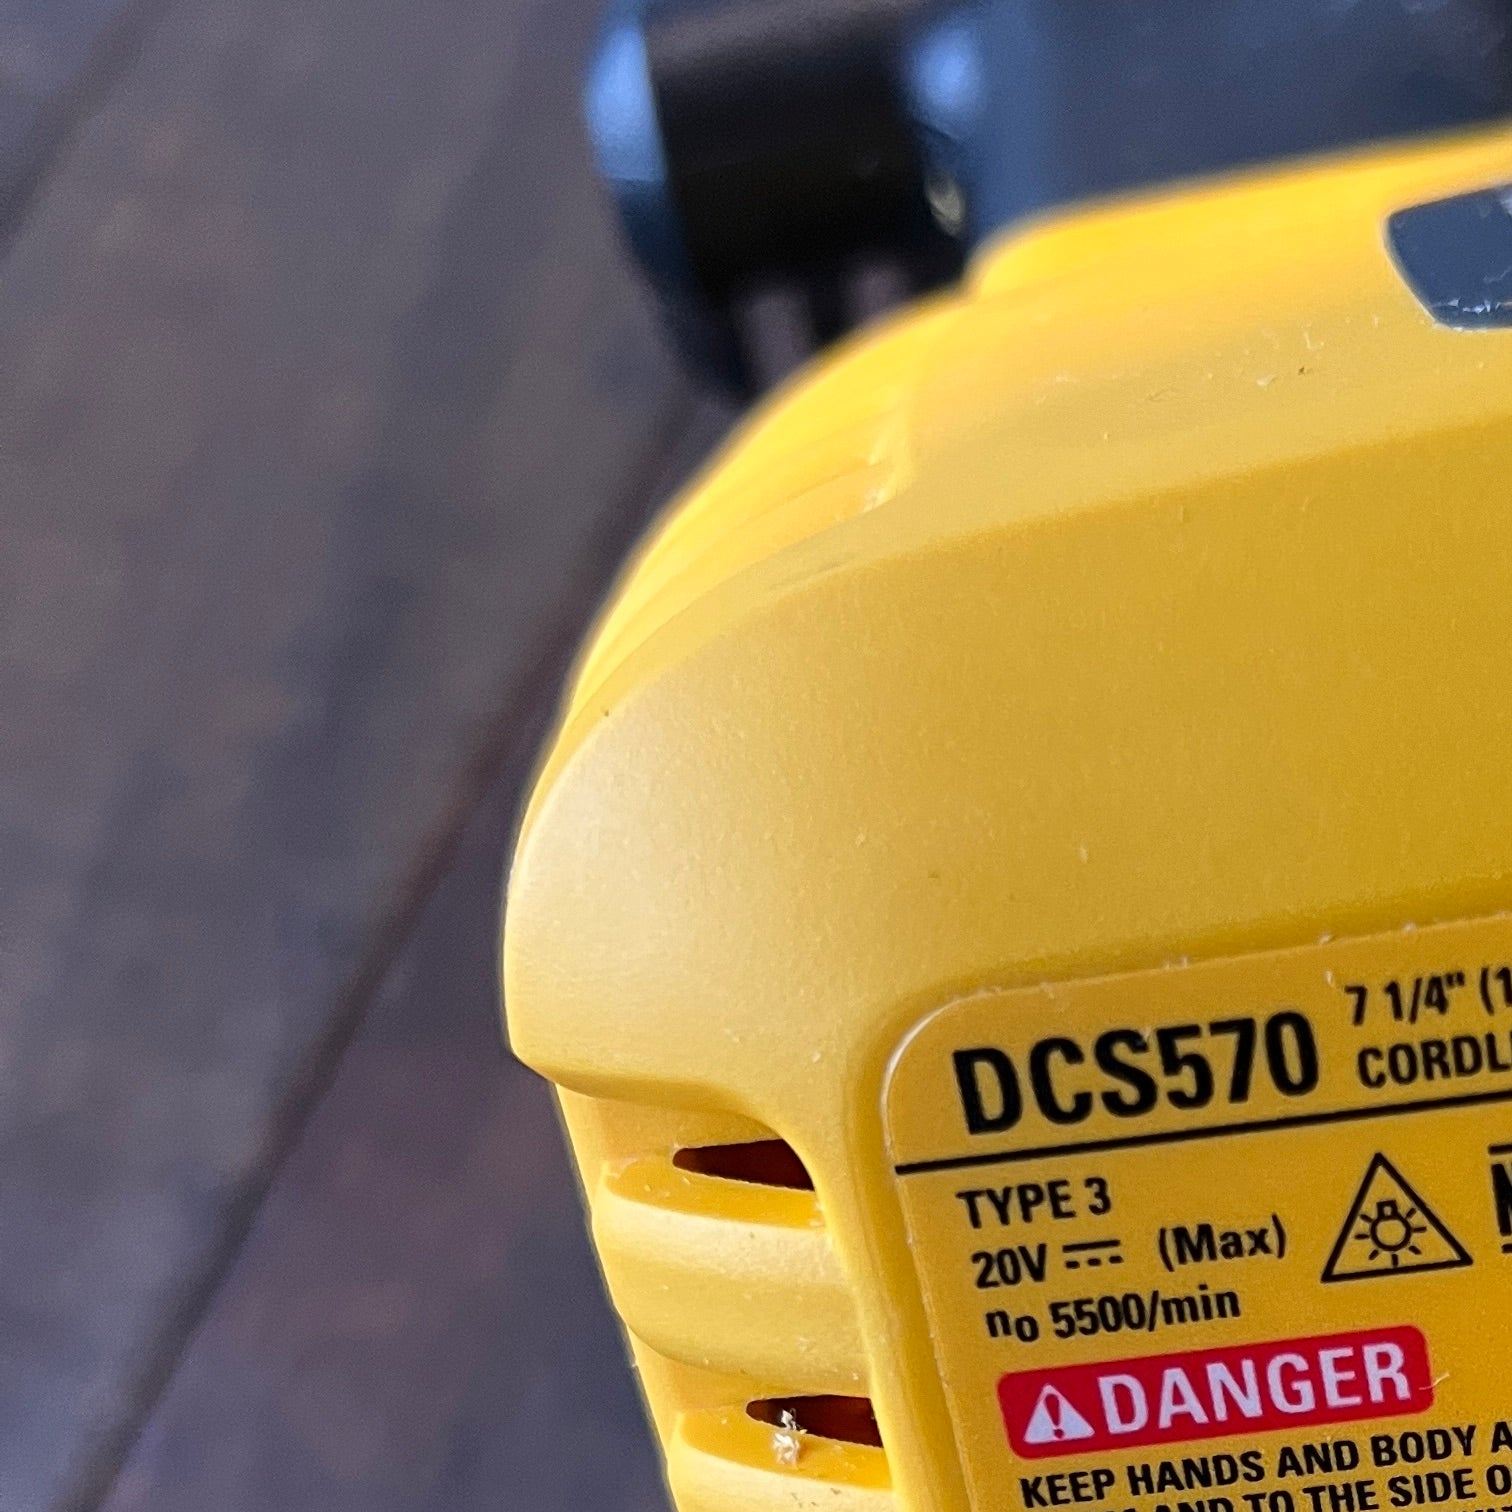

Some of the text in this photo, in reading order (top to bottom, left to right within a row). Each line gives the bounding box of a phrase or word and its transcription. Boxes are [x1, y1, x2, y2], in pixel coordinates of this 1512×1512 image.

[1344, 985, 1368, 1026] 7
[1383, 970, 1466, 1025] 1/4"
[951, 1009, 1320, 1136] DCS570
[955, 1176, 1112, 1229] TYPE 3
[970, 1213, 1287, 1290] 20V (Max)
[1048, 1283, 1241, 1340] 5500/min
[1097, 1341, 1411, 1435] DANGER
[1018, 1468, 1116, 1509] KEEP
[1126, 1450, 1266, 1497] HANDS
[1277, 1439, 1360, 1479] AND
[1369, 1424, 1477, 1468] BODY
[1387, 1468, 1478, 1508] SIDE
